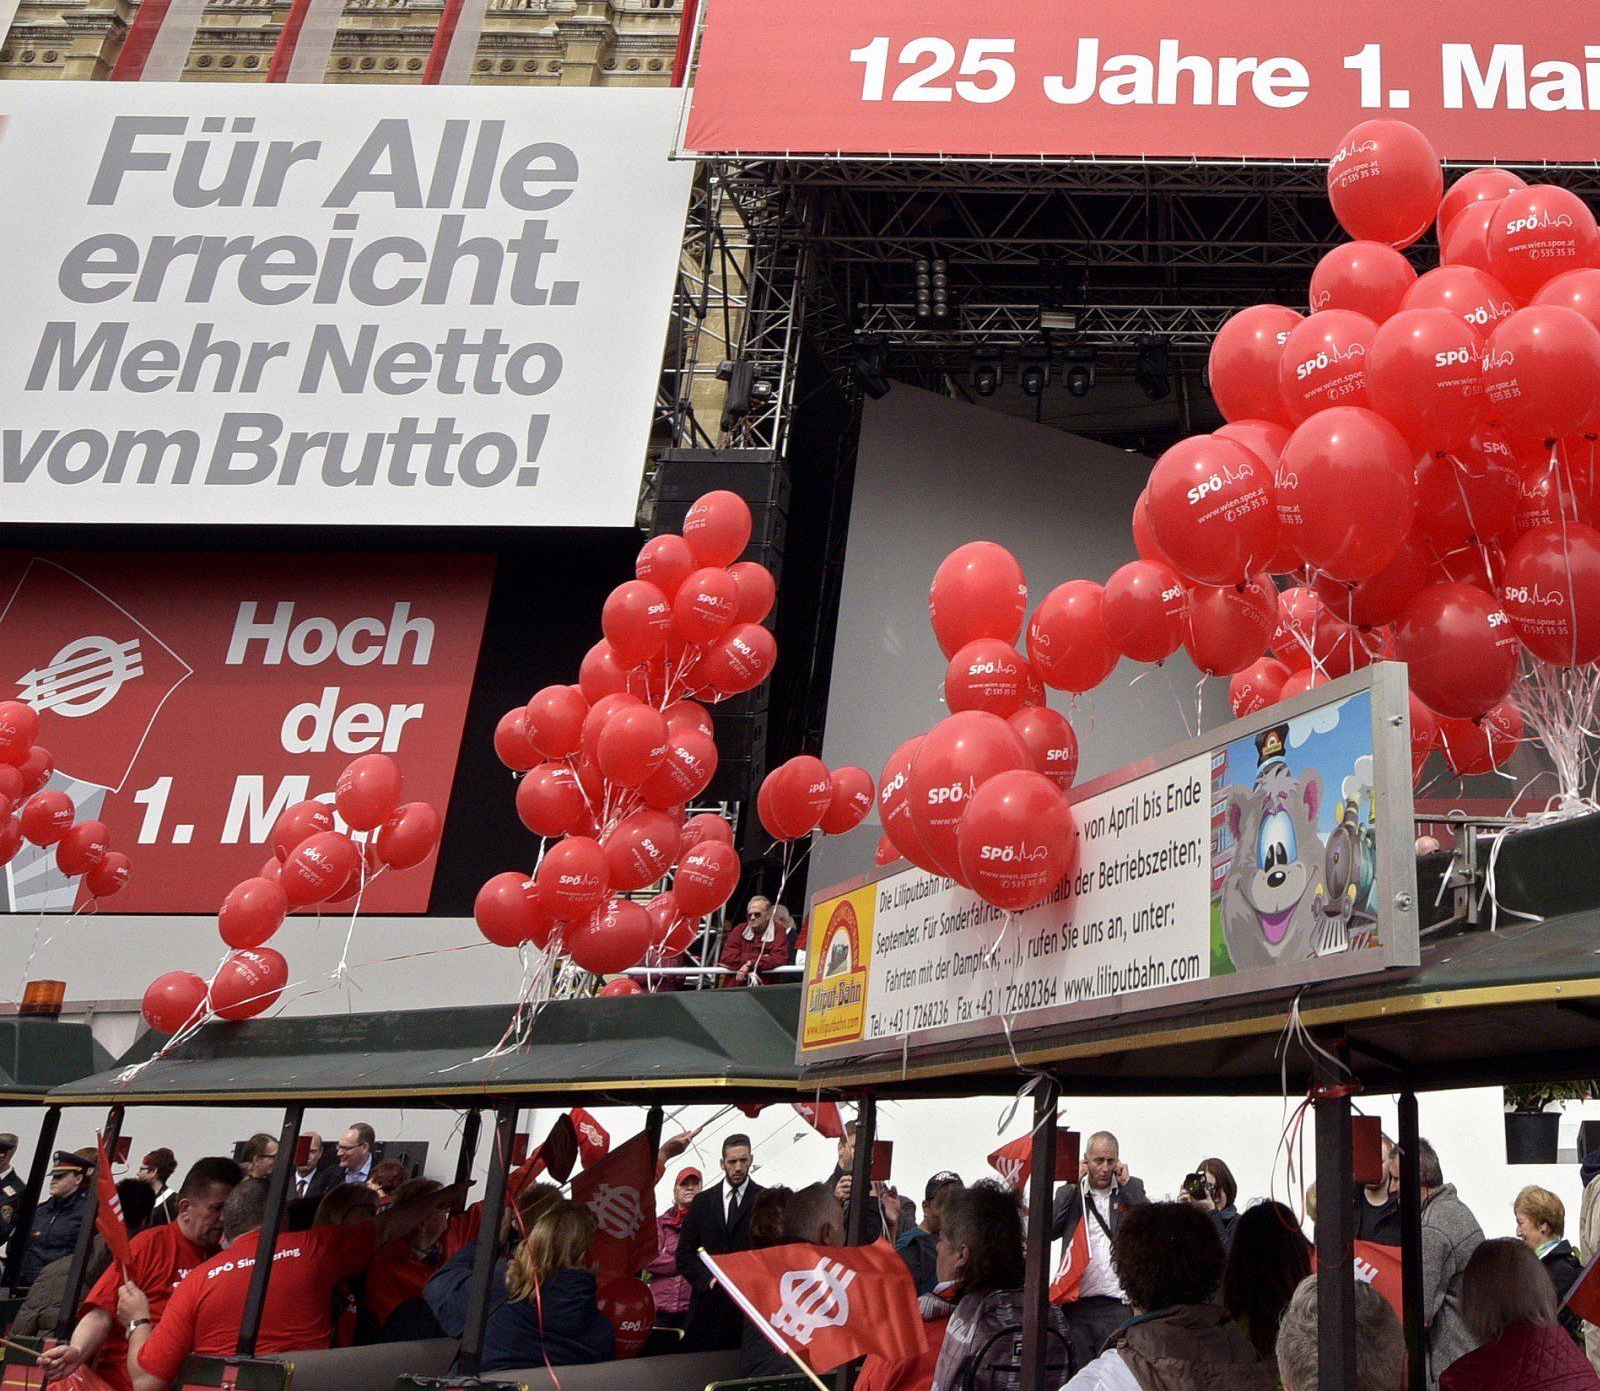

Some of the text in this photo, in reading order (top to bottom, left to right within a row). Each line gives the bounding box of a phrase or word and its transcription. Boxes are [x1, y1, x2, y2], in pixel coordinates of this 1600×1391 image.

[850, 37, 1016, 103] 125
[1044, 38, 1310, 108] Jahre
[1342, 43, 1409, 108] 1.
[87, 116, 580, 212] Für Alle
[1506, 214, 1538, 235] SPÖ
[57, 213, 580, 306] erreicht.
[1541, 248, 1576, 258] 535 35 35
[24, 322, 563, 396] Mehr Netto
[1296, 351, 1328, 380] SPÖ
[1435, 347, 1470, 368] SPÖ
[1340, 384, 1355, 396] 535
[1, 412, 550, 488] vom Brutto!
[1187, 474, 1222, 505] SPÖ
[1236, 505, 1251, 517] 535
[1252, 499, 1261, 510] 35
[1162, 585, 1181, 602] SPÖ
[1505, 586, 1527, 602] SPÖ
[225, 601, 436, 666] Hoch
[968, 662, 994, 676] SPÖ
[280, 687, 424, 754] der
[1046, 748, 1069, 761] SPÖ
[882, 772, 904, 804] SPÖ
[928, 783, 962, 805] SPÖ
[133, 776, 195, 844] 1.
[879, 891, 892, 913] Die
[894, 875, 940, 910] Liliputbahn
[1084, 816, 1105, 841] von
[1108, 798, 1138, 840] April
[1143, 792, 1161, 820] bis
[1167, 776, 1201, 808] Ende
[980, 845, 1013, 862] SPÖ
[559, 874, 580, 886] SPÖ
[876, 924, 920, 958] September.
[922, 916, 938, 942] Für
[1074, 868, 1095, 897] der
[1099, 838, 1201, 891] Betriebszeiten;
[885, 969, 916, 993] Fahrten
[918, 960, 933, 986] mit
[935, 956, 950, 981] der
[1028, 929, 1057, 960] rufen
[1061, 922, 1079, 951] Sie
[1083, 919, 1103, 946] uns
[1107, 915, 1127, 943] an,
[1132, 902, 1175, 933] unter:
[889, 1009, 903, 1032] +43
[912, 999, 949, 1030] 7268236
[957, 996, 972, 1021] Fax
[976, 989, 993, 1016] +43
[1063, 952, 1200, 1002] www.liliputbahn.com
[208, 1262, 234, 1279] SPÖ
